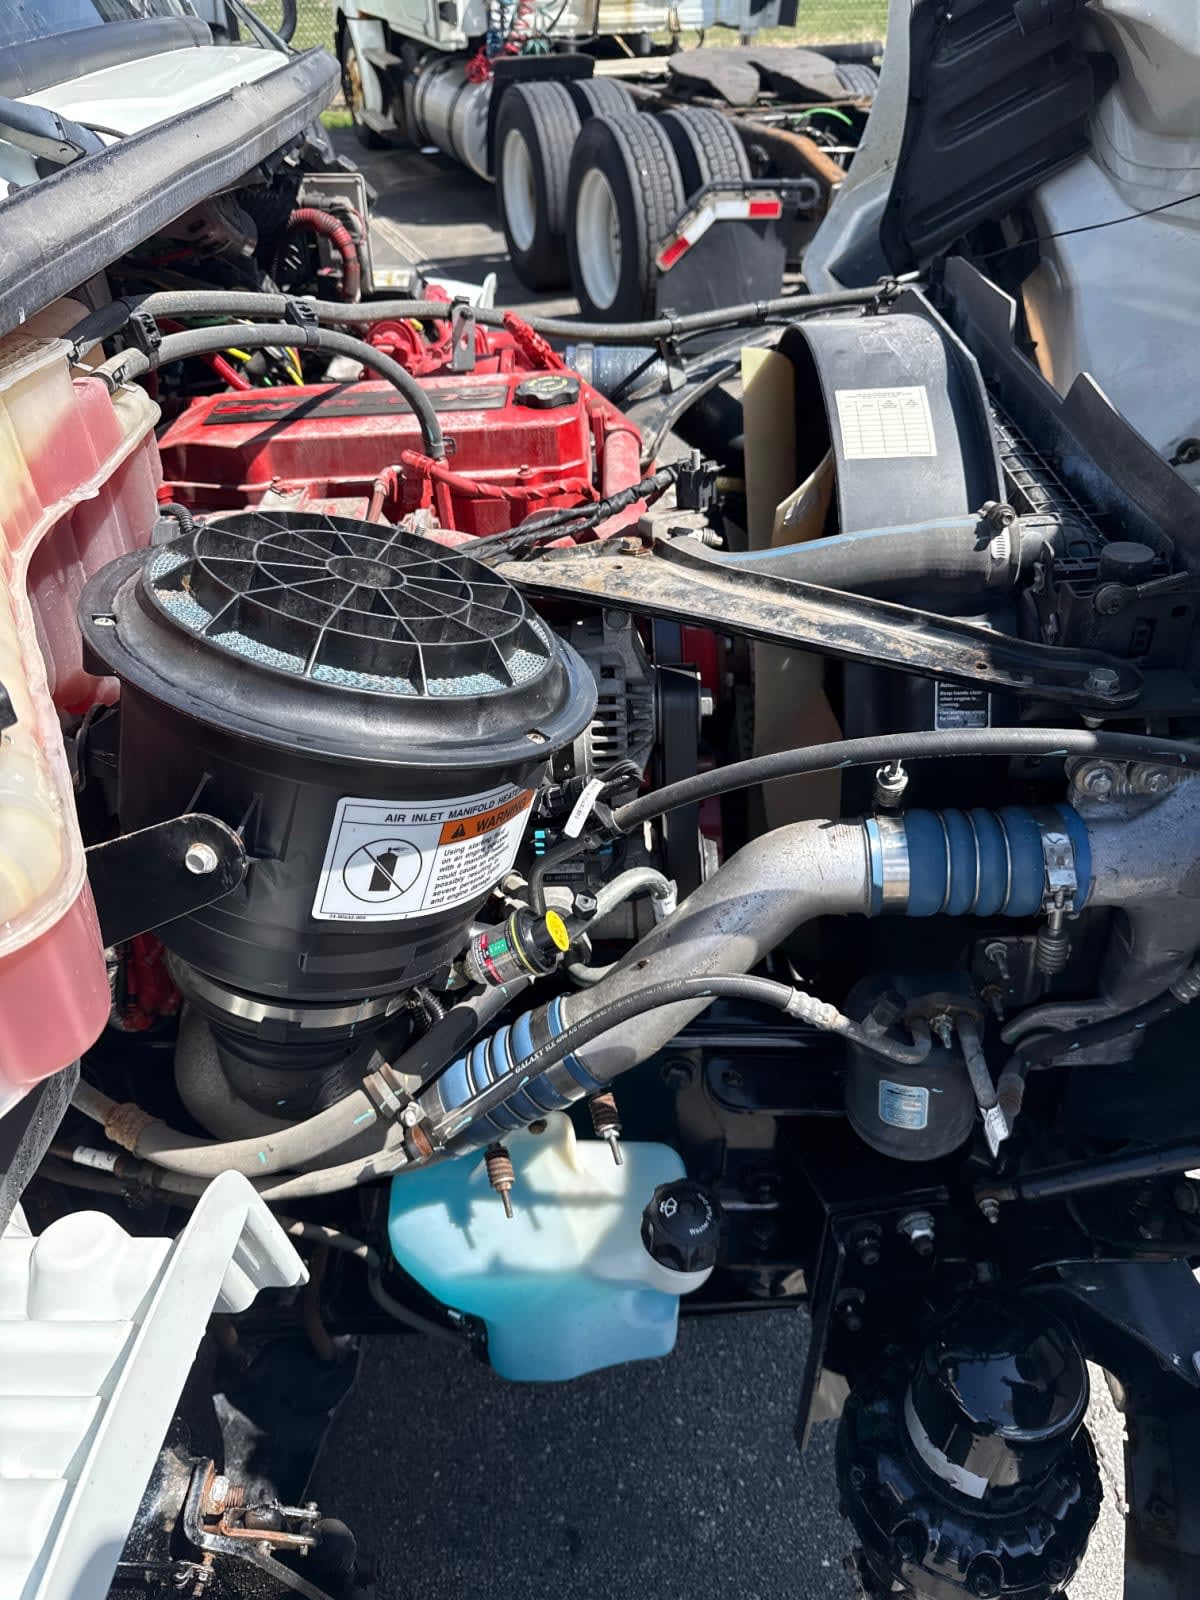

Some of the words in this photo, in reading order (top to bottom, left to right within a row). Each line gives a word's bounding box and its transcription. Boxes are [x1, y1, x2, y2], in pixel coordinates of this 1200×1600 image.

[385, 813, 406, 823] AIR
[411, 812, 444, 823] INLET
[447, 800, 496, 819] MANIFOLD
[476, 796, 528, 833] WARNING
[444, 846, 466, 857] Using
[436, 870, 457, 881] could
[440, 864, 455, 873] with
[514, 1048, 544, 1074] GALAXY
